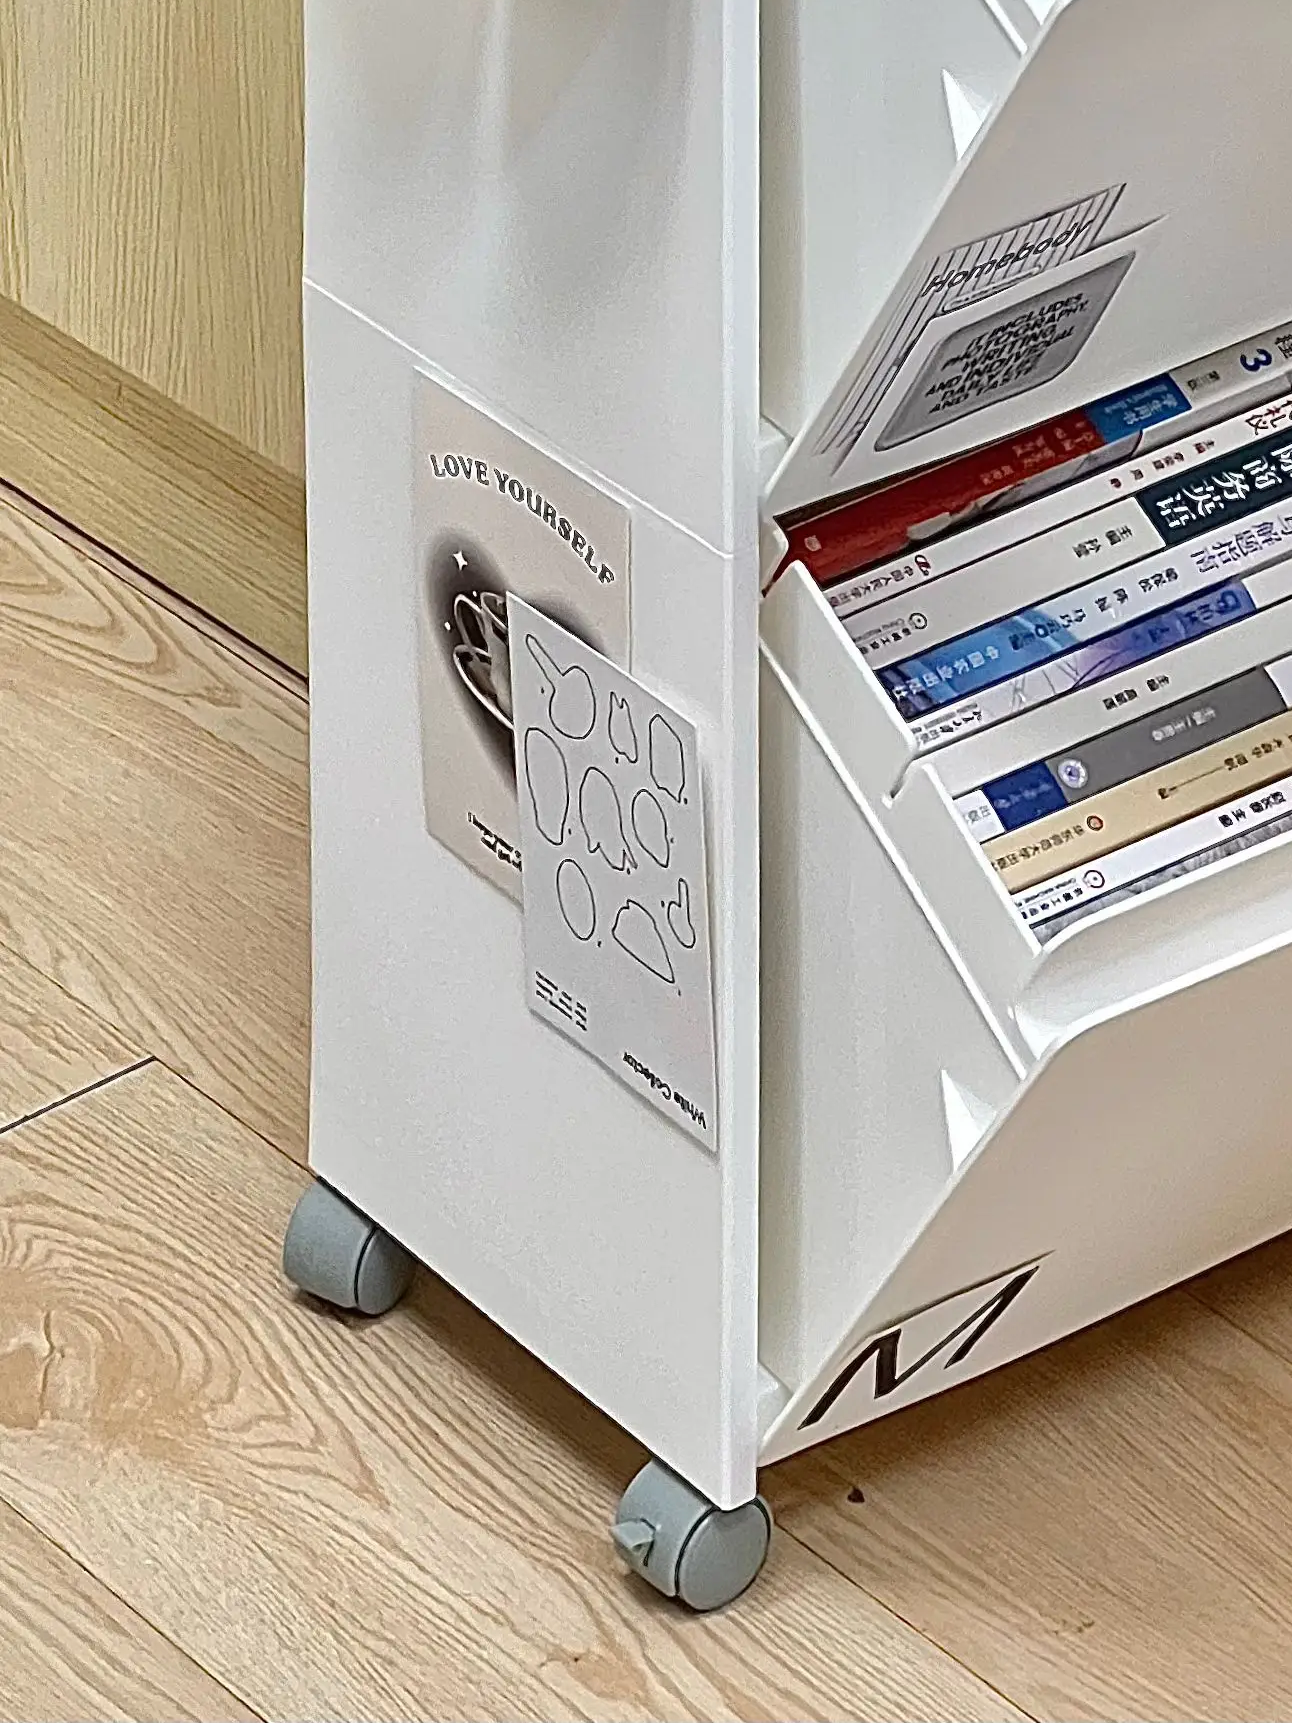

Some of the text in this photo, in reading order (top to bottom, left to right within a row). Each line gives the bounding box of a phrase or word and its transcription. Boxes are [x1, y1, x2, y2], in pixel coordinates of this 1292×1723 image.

[921, 219, 1094, 297] Homebody
[1236, 346, 1276, 374] 3
[429, 453, 616, 585] LOVE YOURSELF
